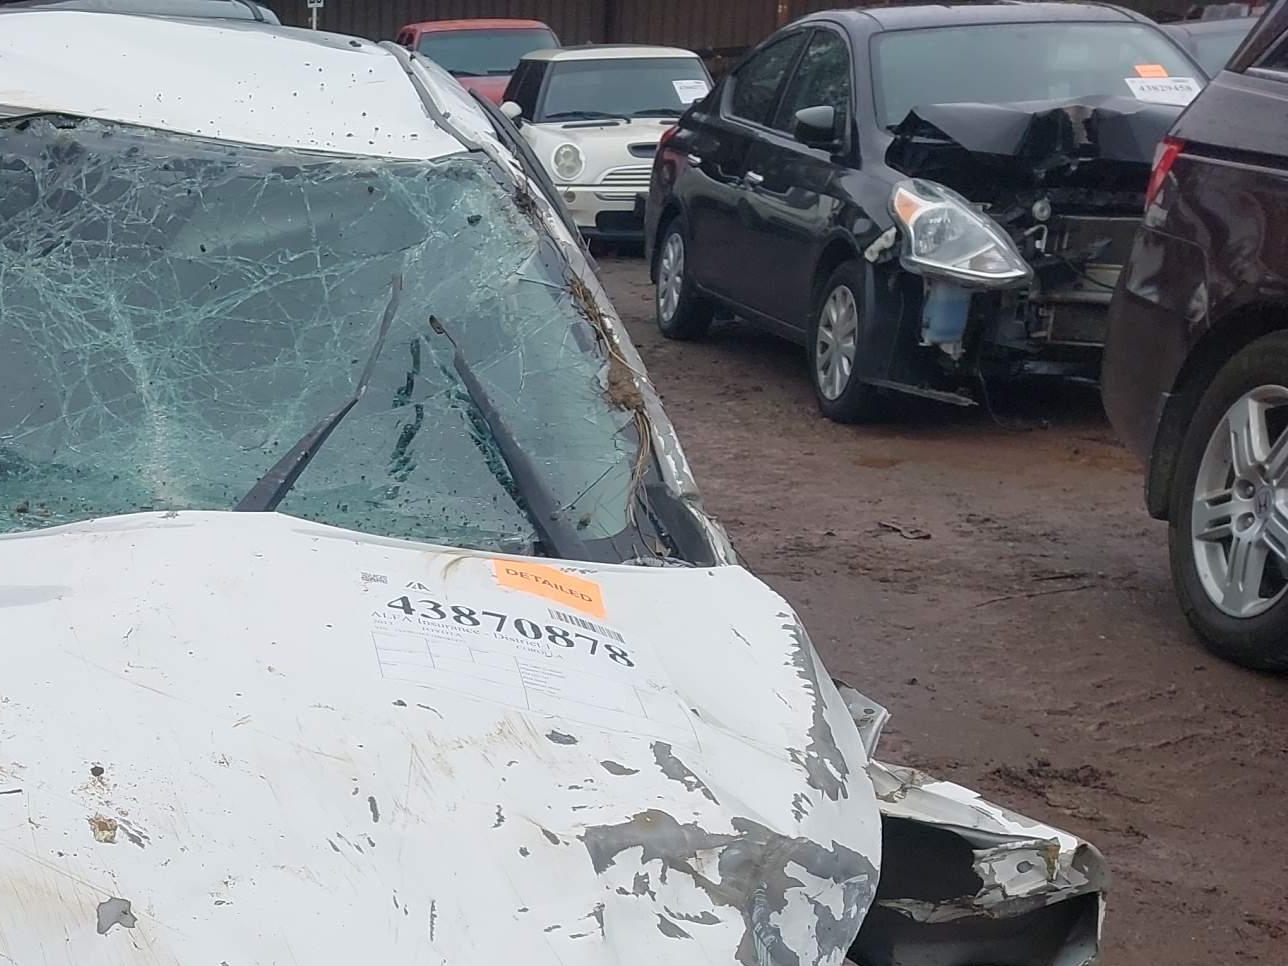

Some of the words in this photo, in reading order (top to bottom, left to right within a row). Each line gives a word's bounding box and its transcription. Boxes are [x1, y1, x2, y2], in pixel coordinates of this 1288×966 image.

[505, 568, 592, 602] DETAILED
[387, 595, 635, 668] 43870878
[417, 618, 481, 635] Insurance
